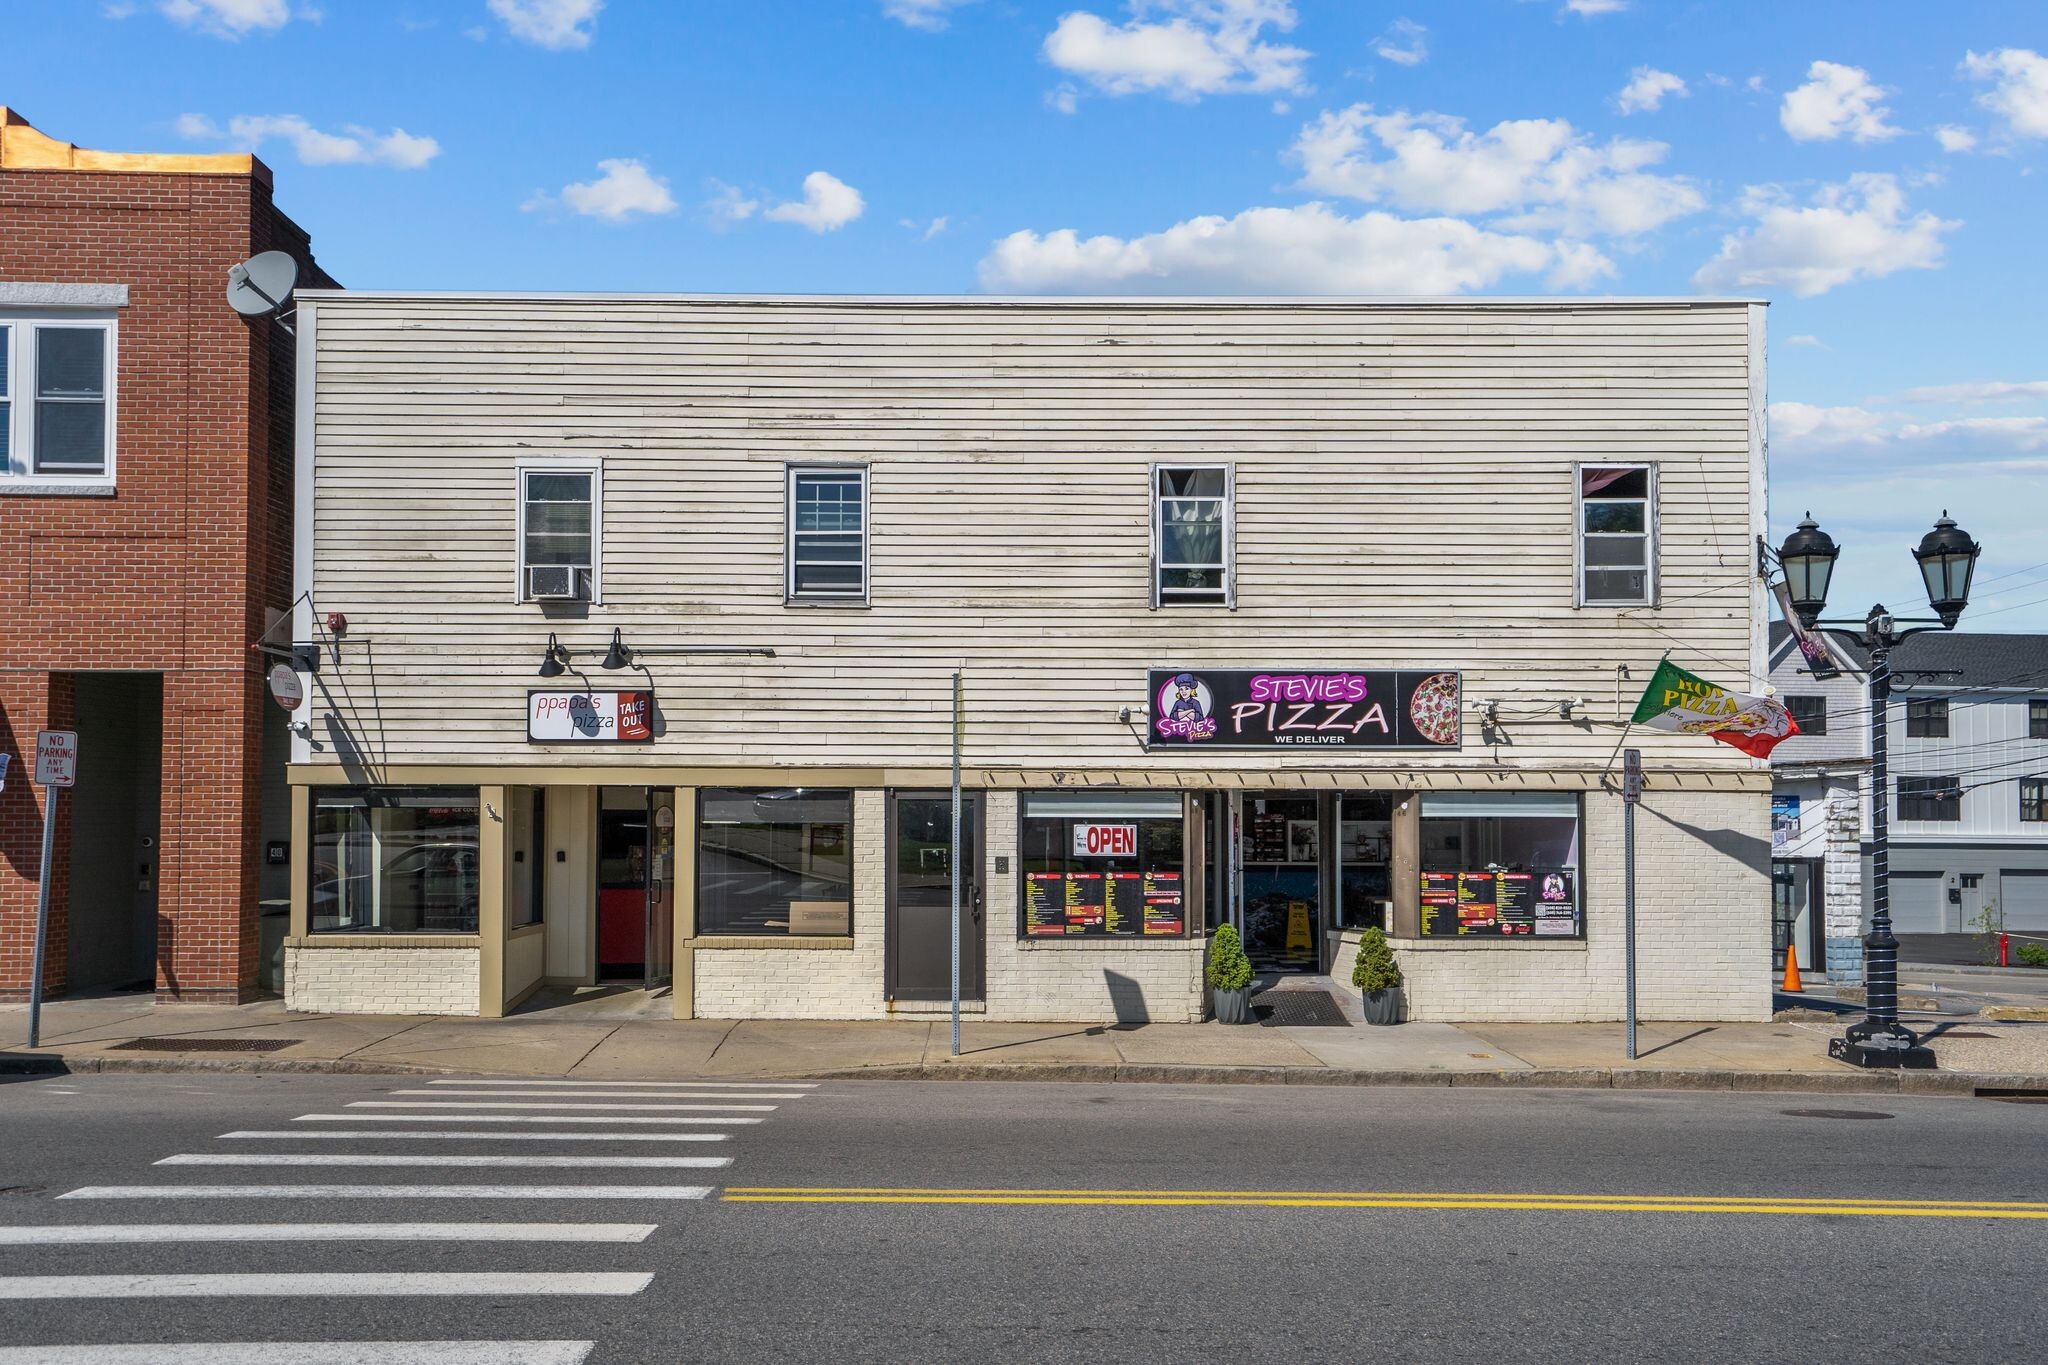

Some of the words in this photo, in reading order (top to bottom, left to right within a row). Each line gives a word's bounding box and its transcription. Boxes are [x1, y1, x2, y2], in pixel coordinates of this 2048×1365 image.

[1253, 676, 1364, 699] STEVIE'S
[535, 694, 601, 720] ppapa's
[619, 700, 645, 715] TAKE
[1663, 689, 1739, 717] PIZZA
[571, 713, 614, 738] pizza
[622, 713, 644, 727] OUT
[1158, 718, 1216, 735] STEVIE'S
[1230, 702, 1389, 734] PIZZA
[49, 736, 64, 746] NO
[1274, 735, 1293, 743] WE
[1296, 735, 1345, 743] DELIVER
[39, 747, 73, 759] PARKING
[46, 766, 65, 775] TIME
[1087, 826, 1134, 854] OPEN
